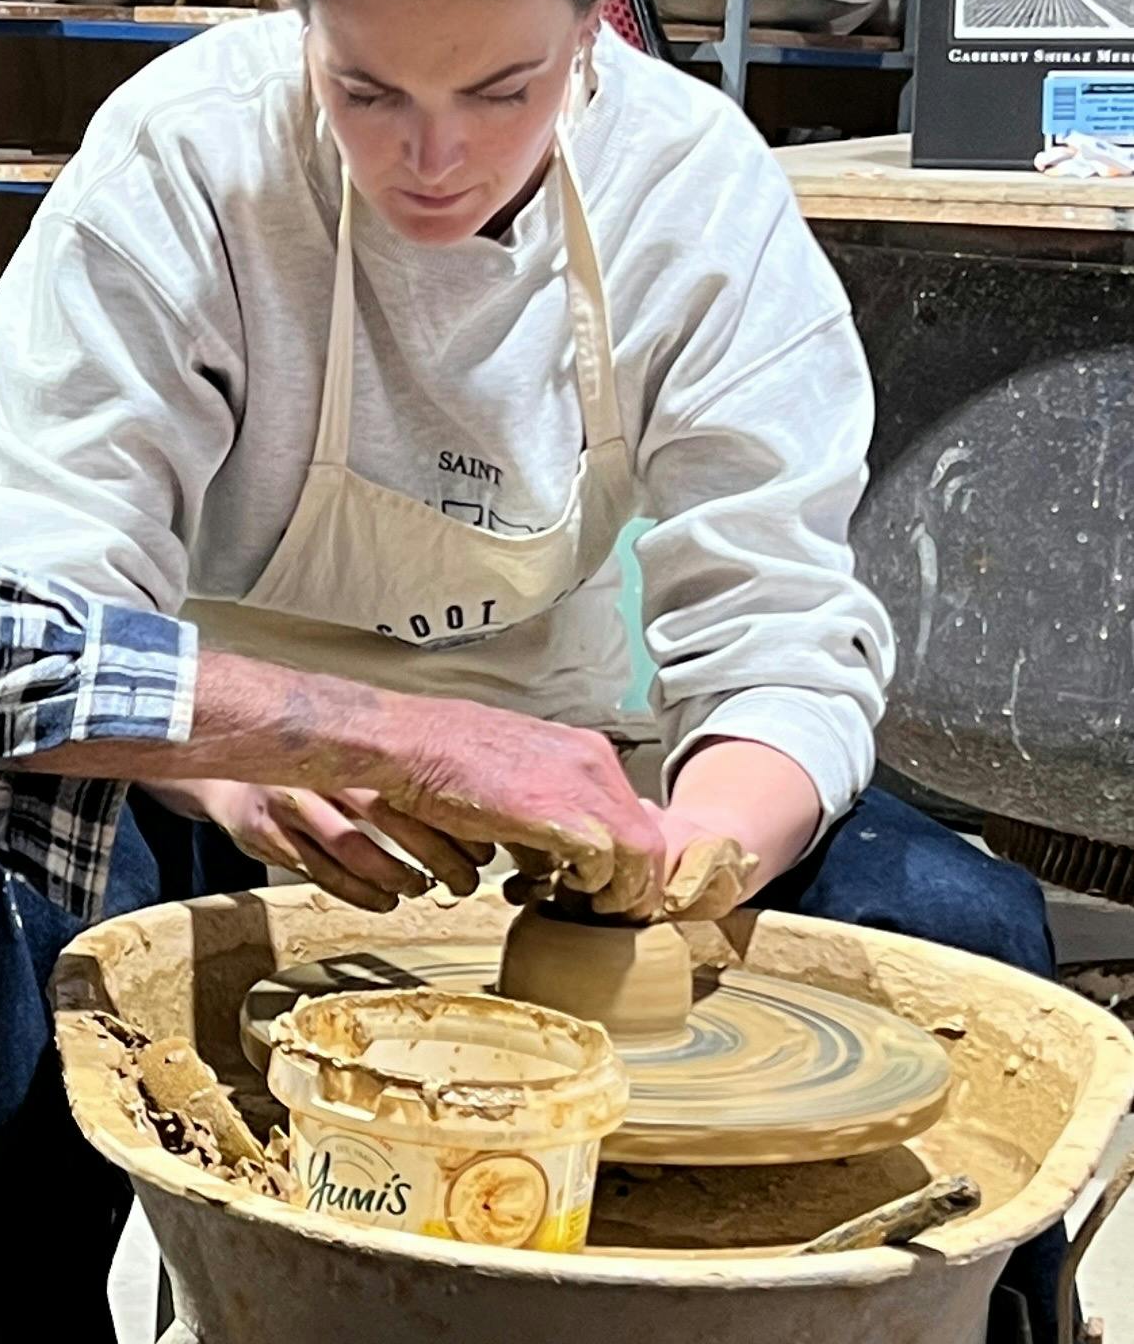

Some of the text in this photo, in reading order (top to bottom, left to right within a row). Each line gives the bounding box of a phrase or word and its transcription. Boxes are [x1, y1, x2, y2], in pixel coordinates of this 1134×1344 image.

[947, 48, 1029, 64] CABERNET
[1033, 48, 1092, 64] SHIRAZ
[437, 450, 504, 486] SAINT
[305, 1150, 413, 1216] Yumi's
